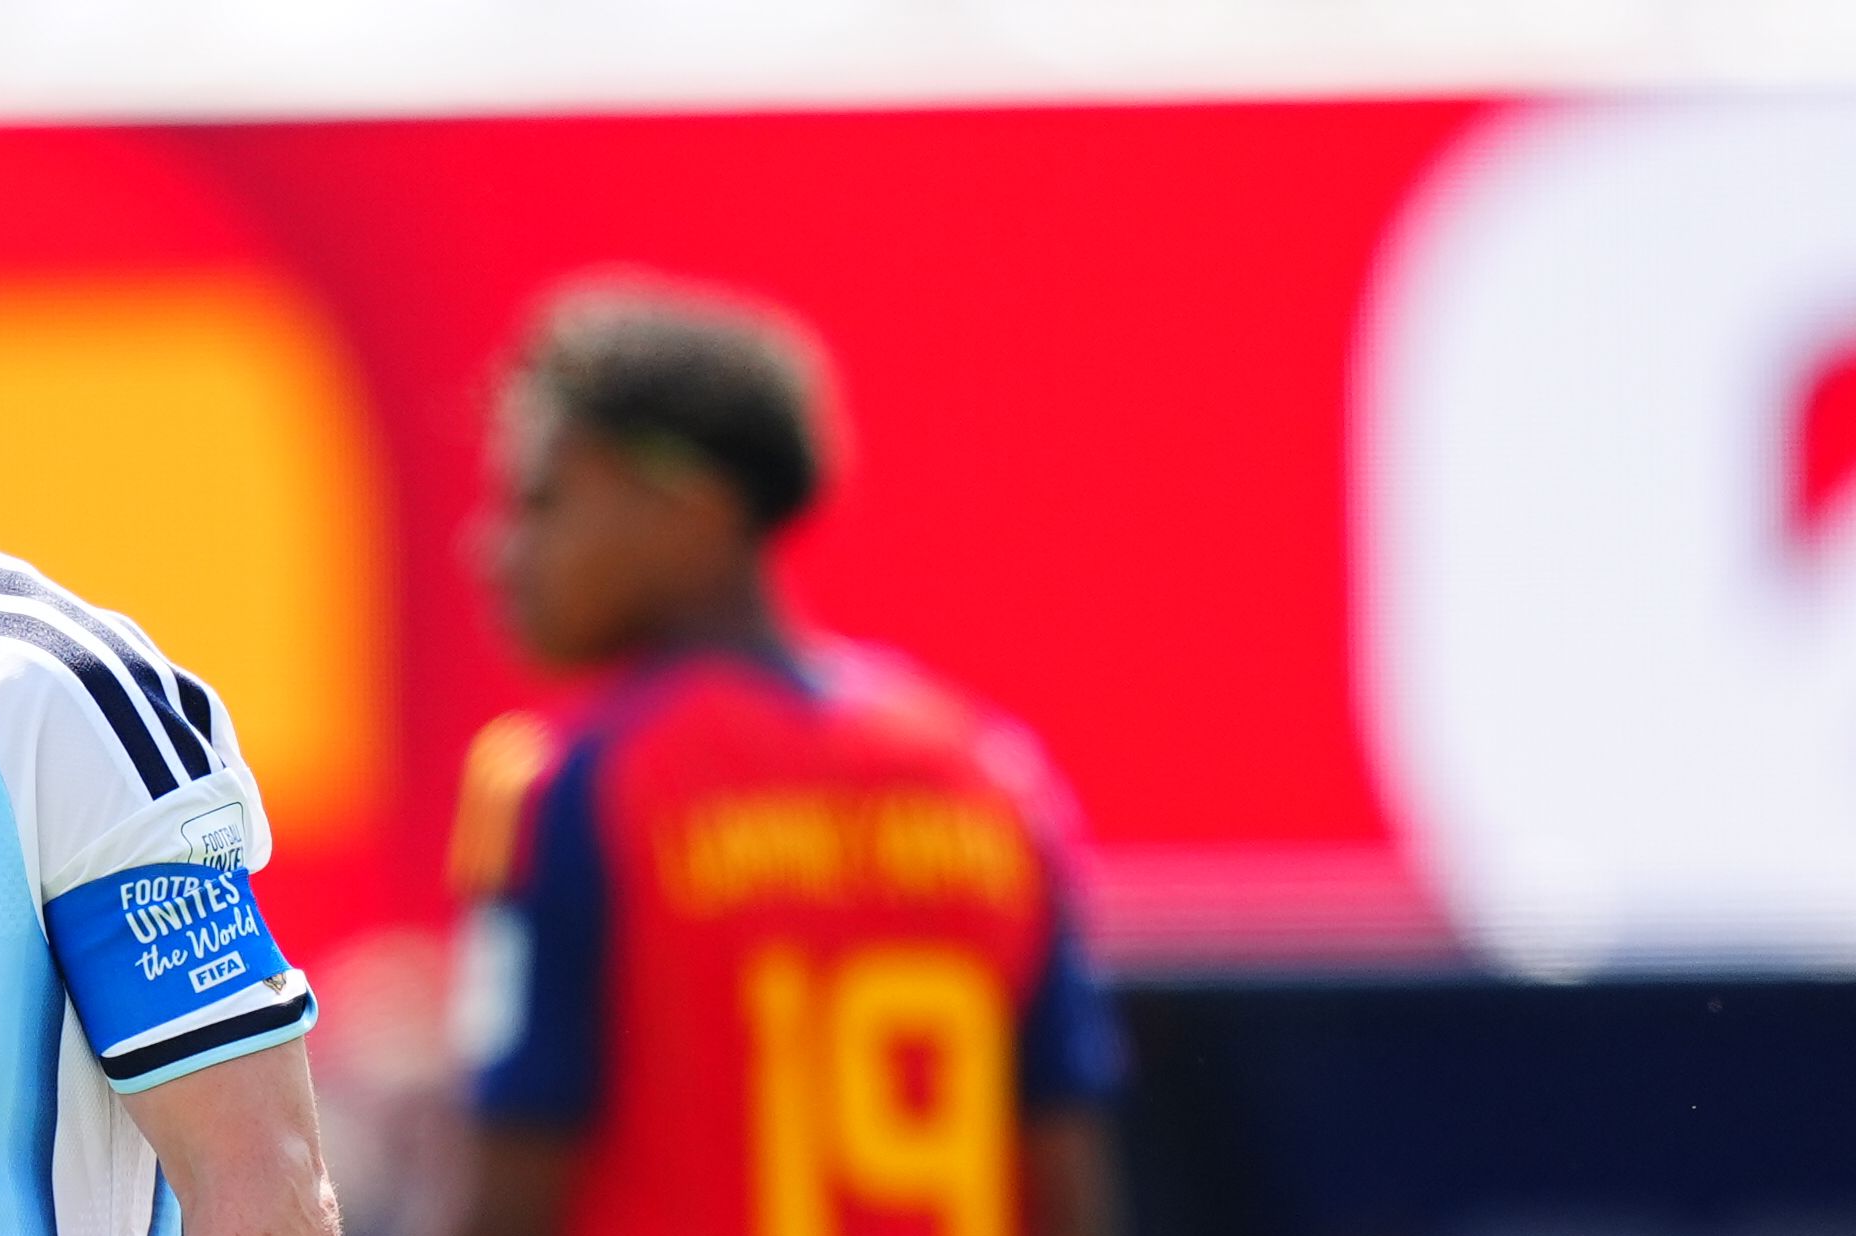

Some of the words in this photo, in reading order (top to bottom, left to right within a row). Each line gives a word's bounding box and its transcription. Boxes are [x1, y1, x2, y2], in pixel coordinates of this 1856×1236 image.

[120, 875, 201, 911] FOOTB
[125, 871, 241, 945] UNITES
[135, 943, 189, 982] the
[185, 903, 261, 959] World
[195, 957, 242, 987] FIFA
